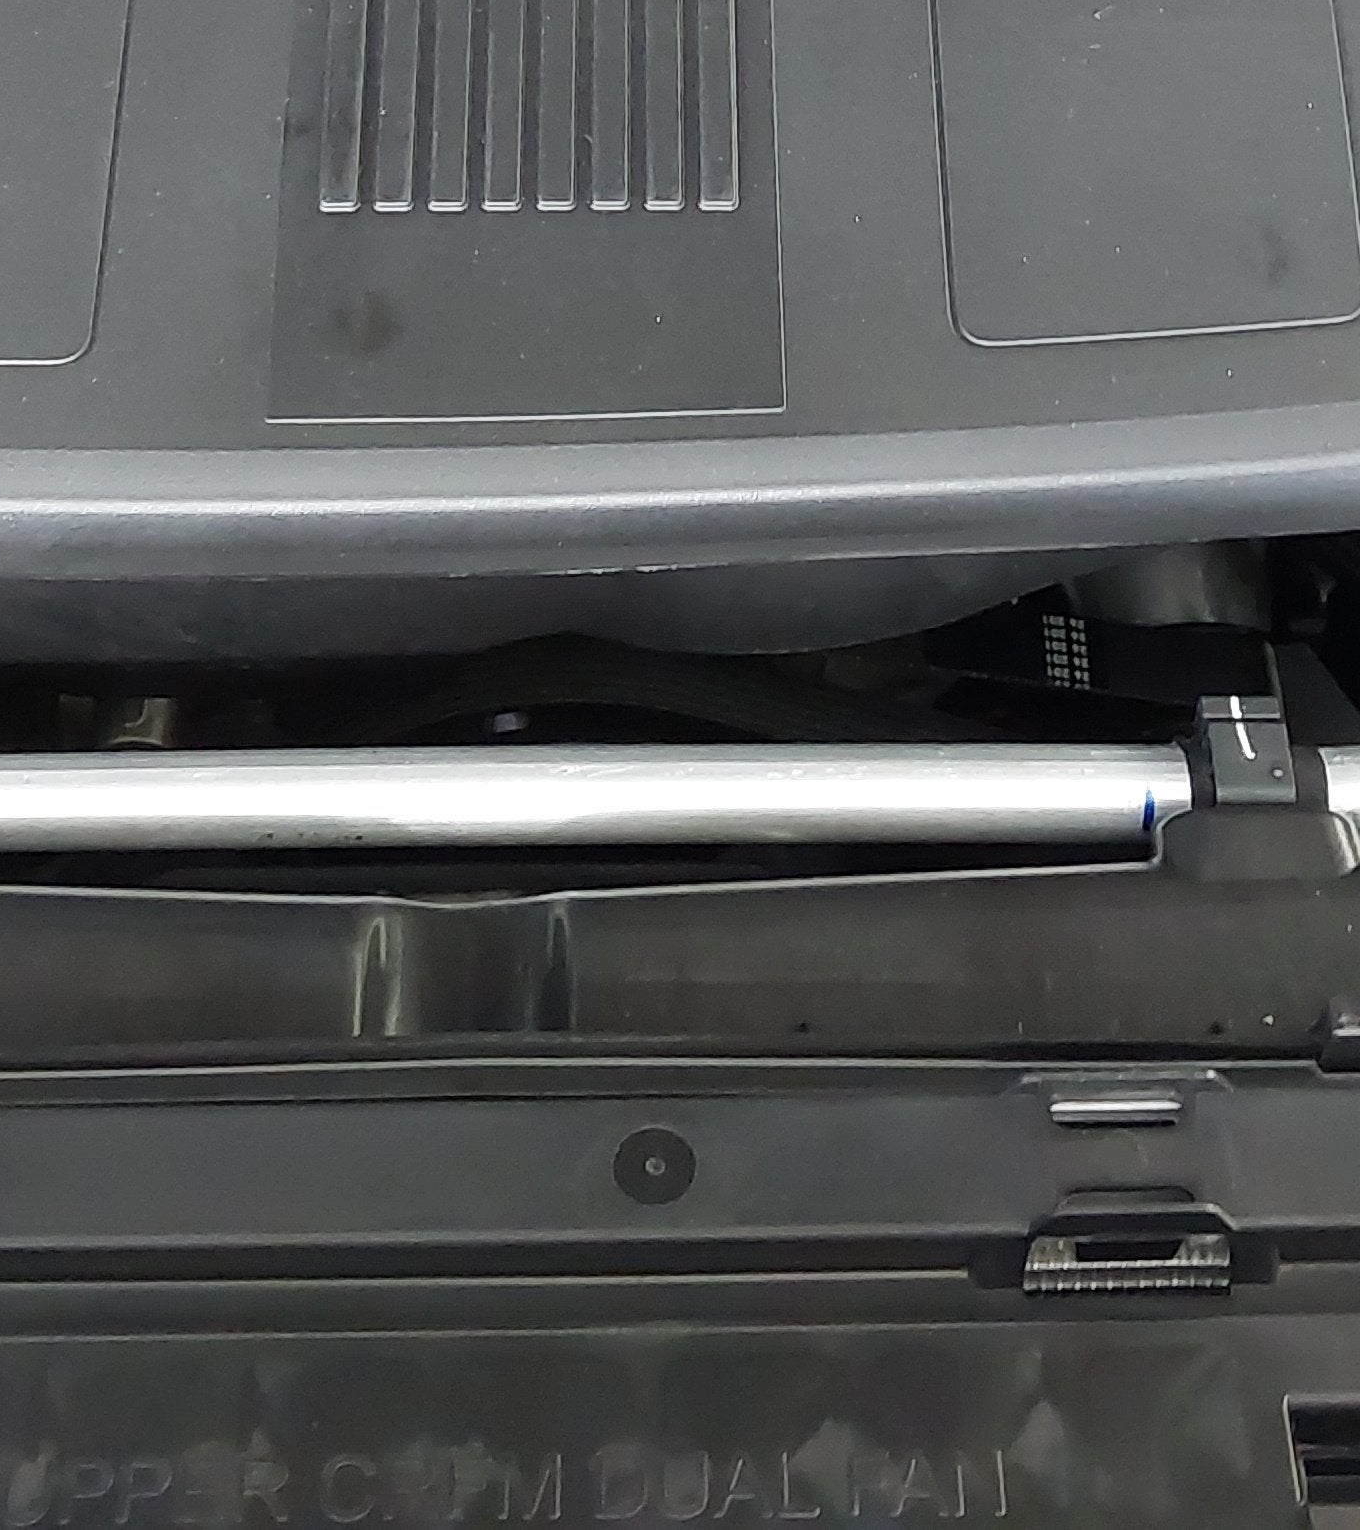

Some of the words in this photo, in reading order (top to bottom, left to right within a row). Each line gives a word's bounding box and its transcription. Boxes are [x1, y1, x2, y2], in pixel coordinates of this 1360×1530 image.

[3, 1452, 292, 1528] UPPER
[589, 1448, 822, 1522] DUAL
[846, 1447, 1008, 1520] FAN
